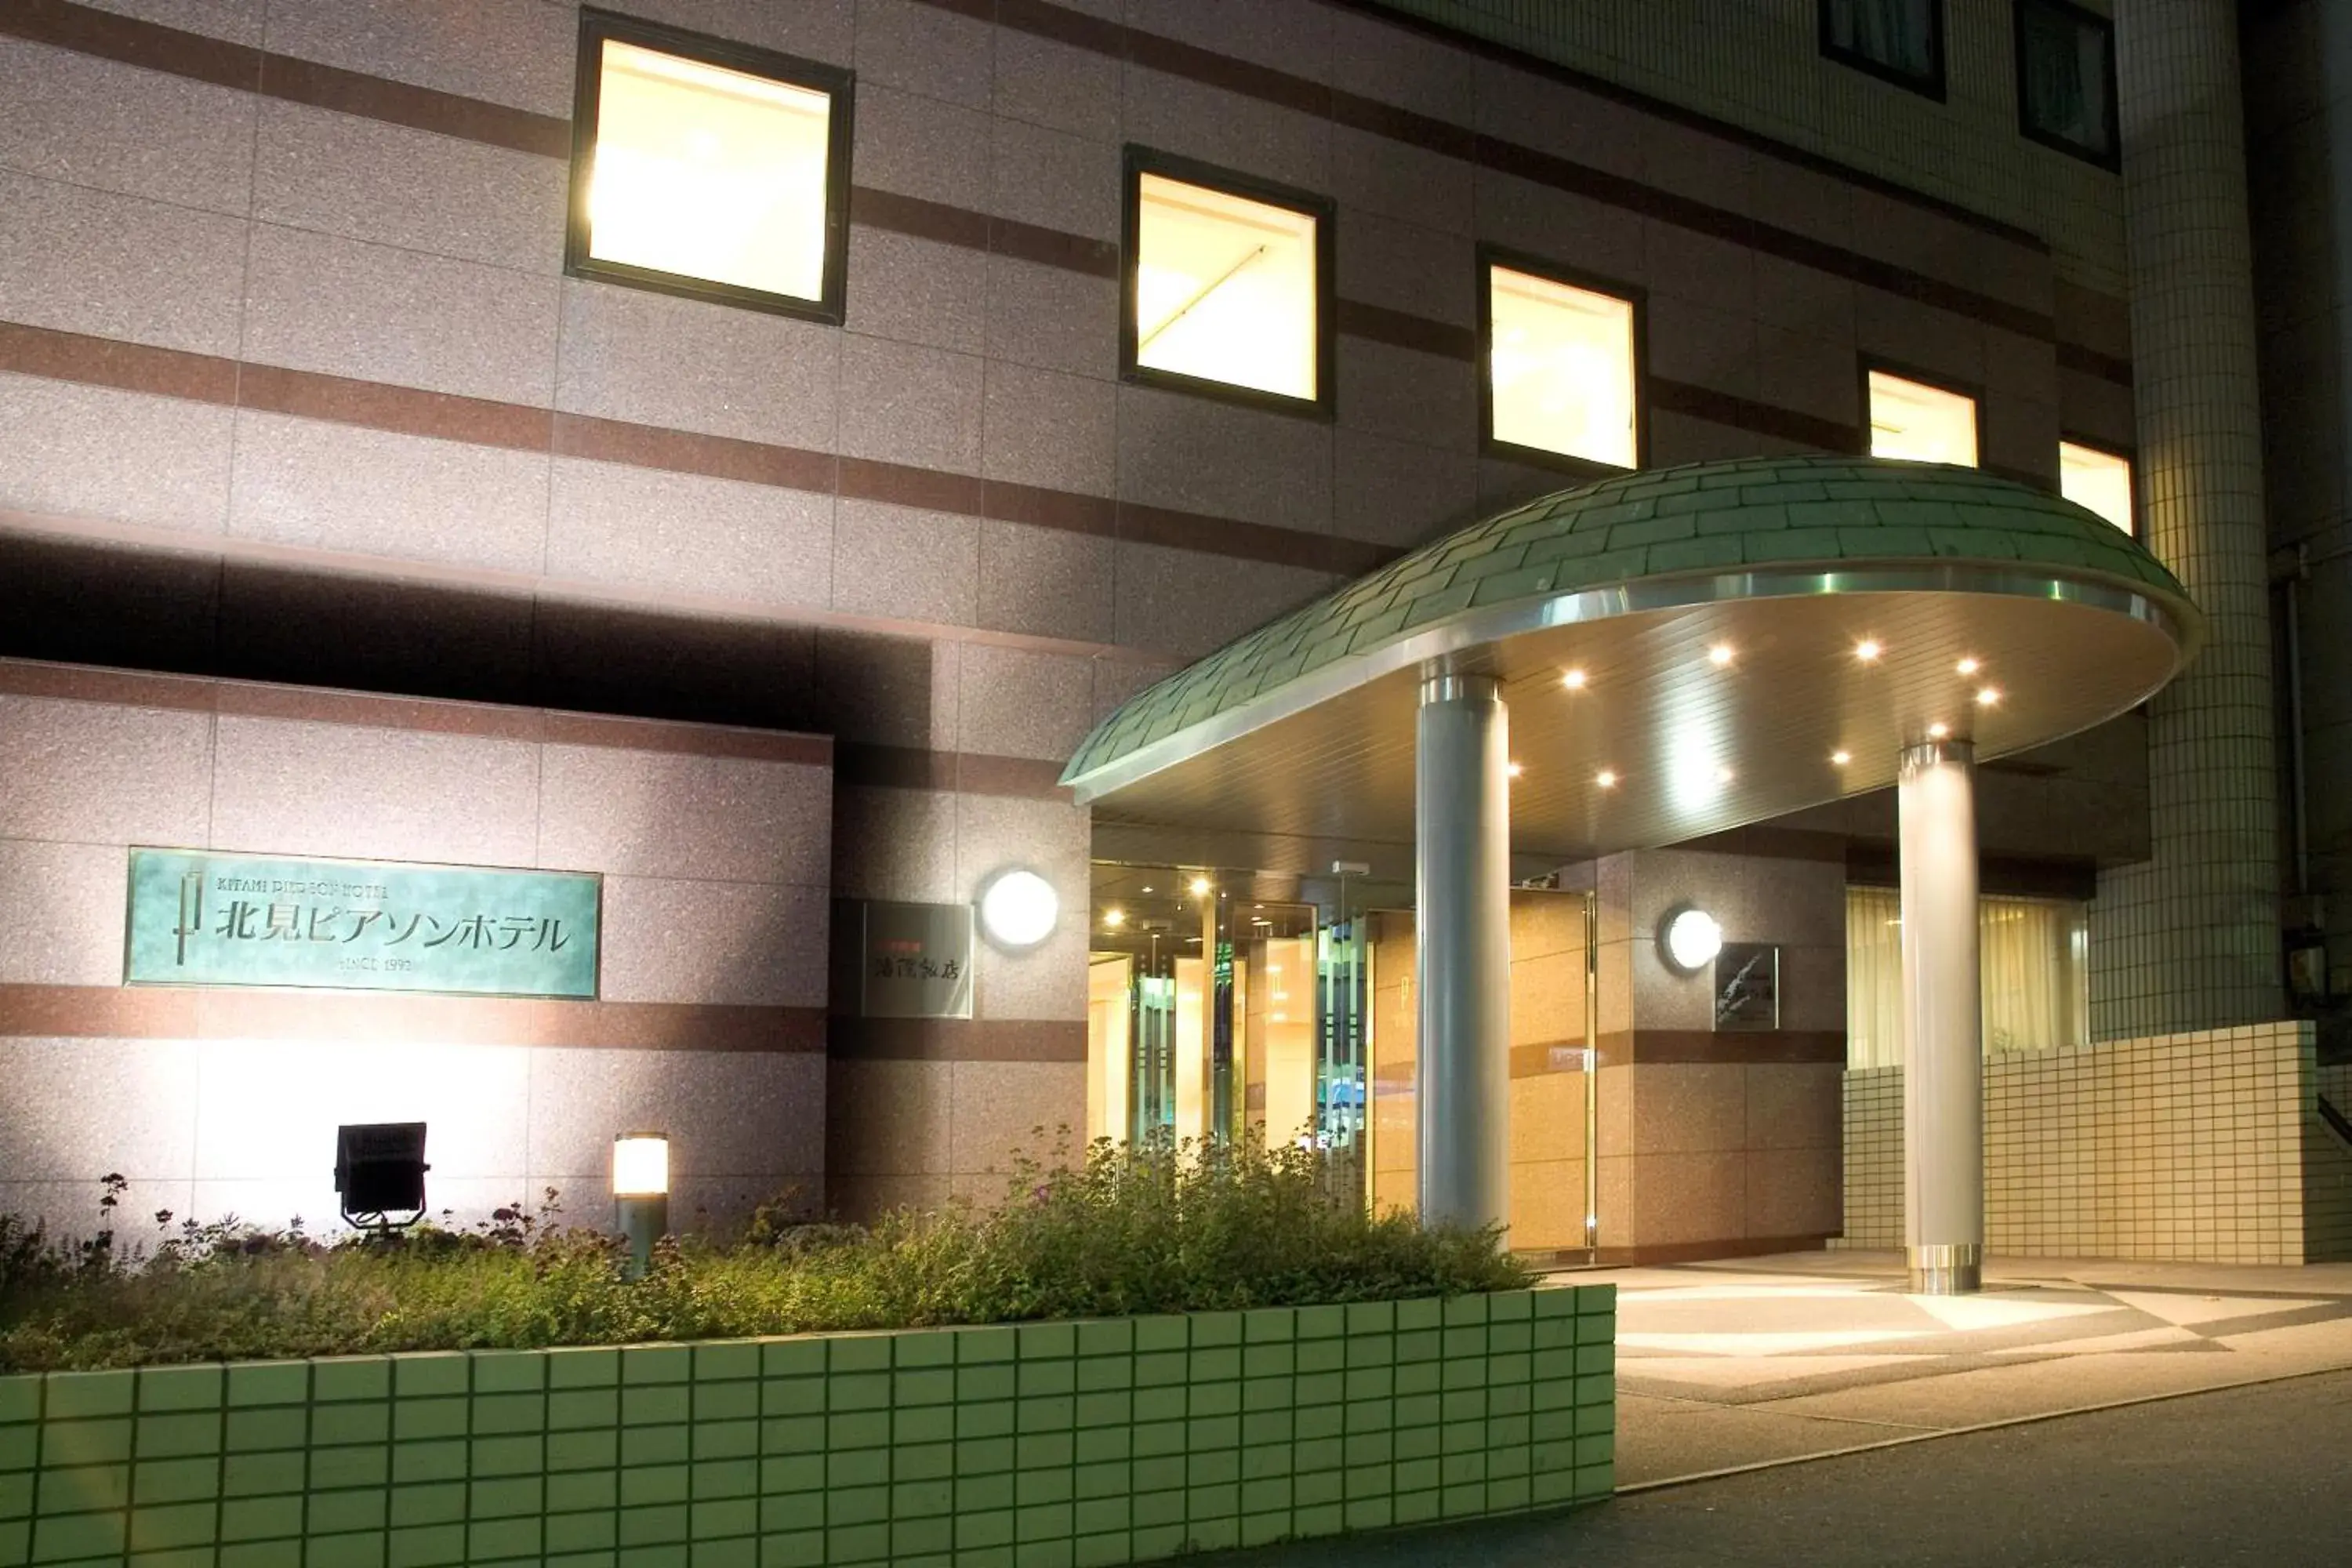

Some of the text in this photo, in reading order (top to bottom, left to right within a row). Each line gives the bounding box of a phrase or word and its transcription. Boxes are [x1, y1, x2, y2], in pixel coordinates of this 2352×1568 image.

[216, 877, 267, 893] KITAMI
[216, 901, 572, 952] 北見ピアソンホテル
